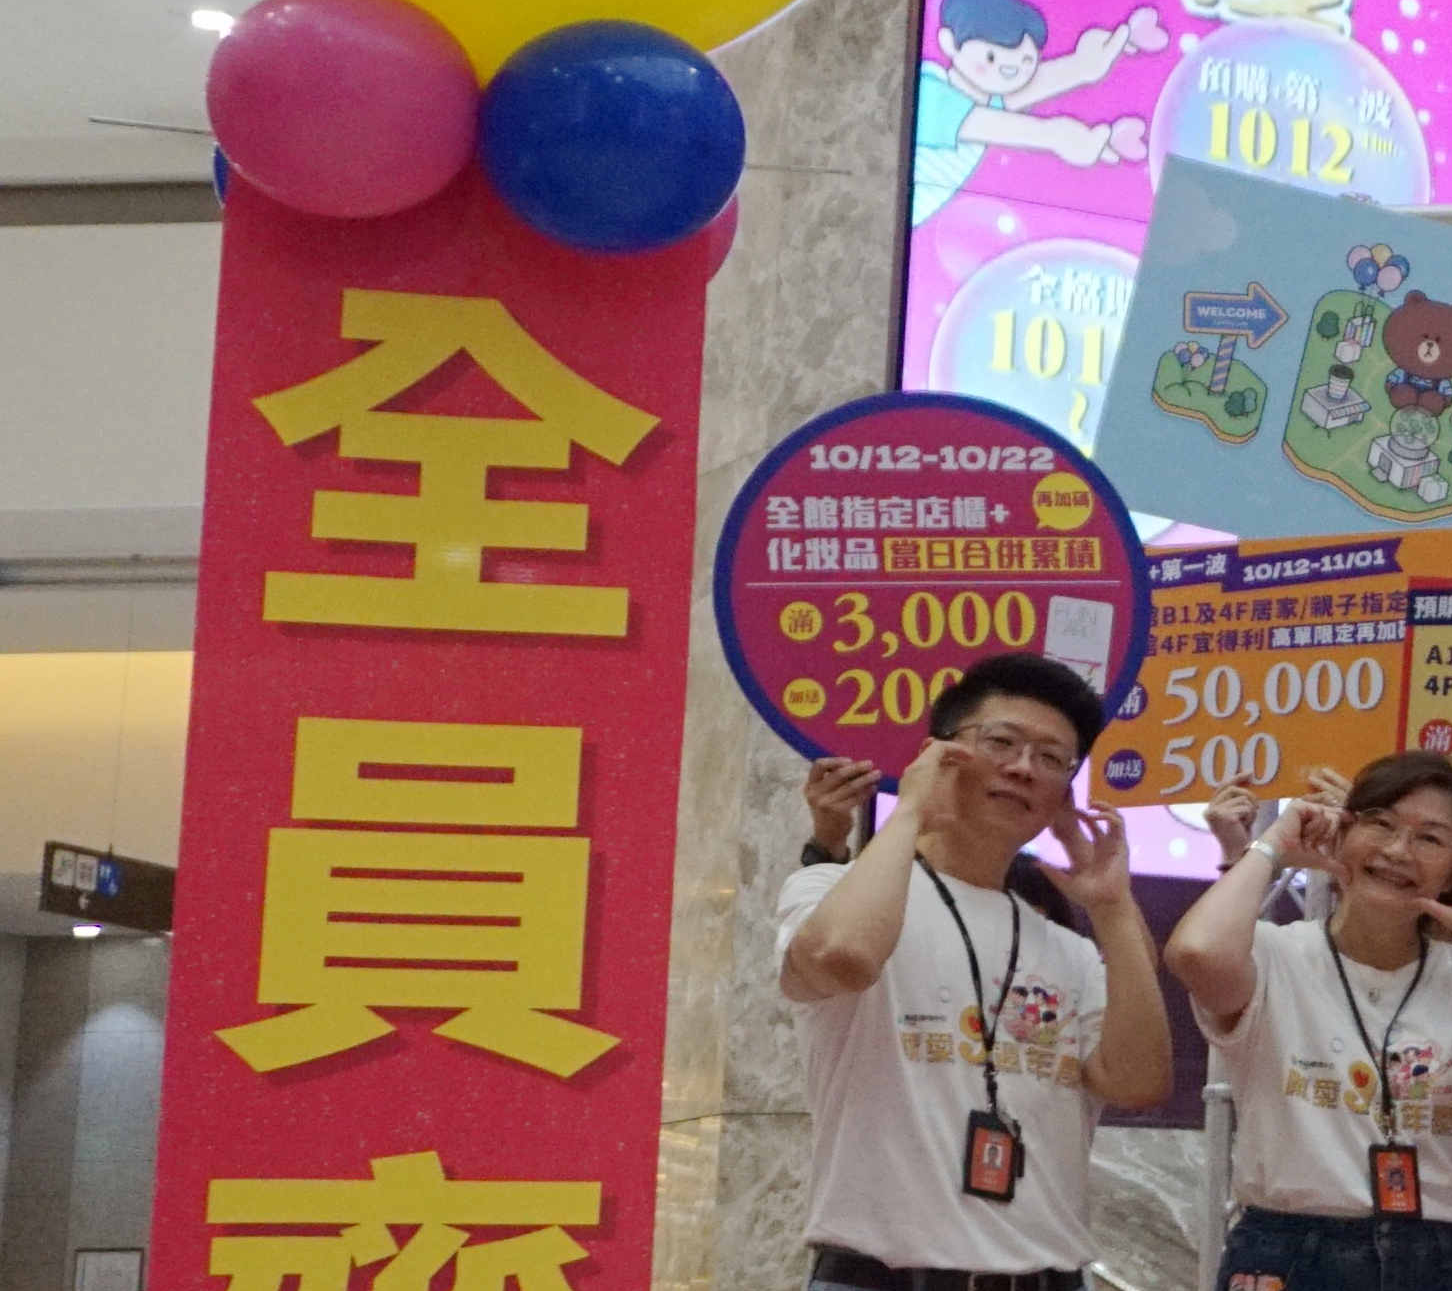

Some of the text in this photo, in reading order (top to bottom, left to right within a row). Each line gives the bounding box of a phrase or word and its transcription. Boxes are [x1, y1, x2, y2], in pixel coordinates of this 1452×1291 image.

[1197, 306, 1266, 320] WELCOME
[809, 444, 1056, 472] 10/12-10/22
[1243, 549, 1385, 582] 10/12-11/01
[832, 591, 1036, 658] 3,000
[1163, 657, 1384, 725] 50,000
[1161, 732, 1280, 796] 500
